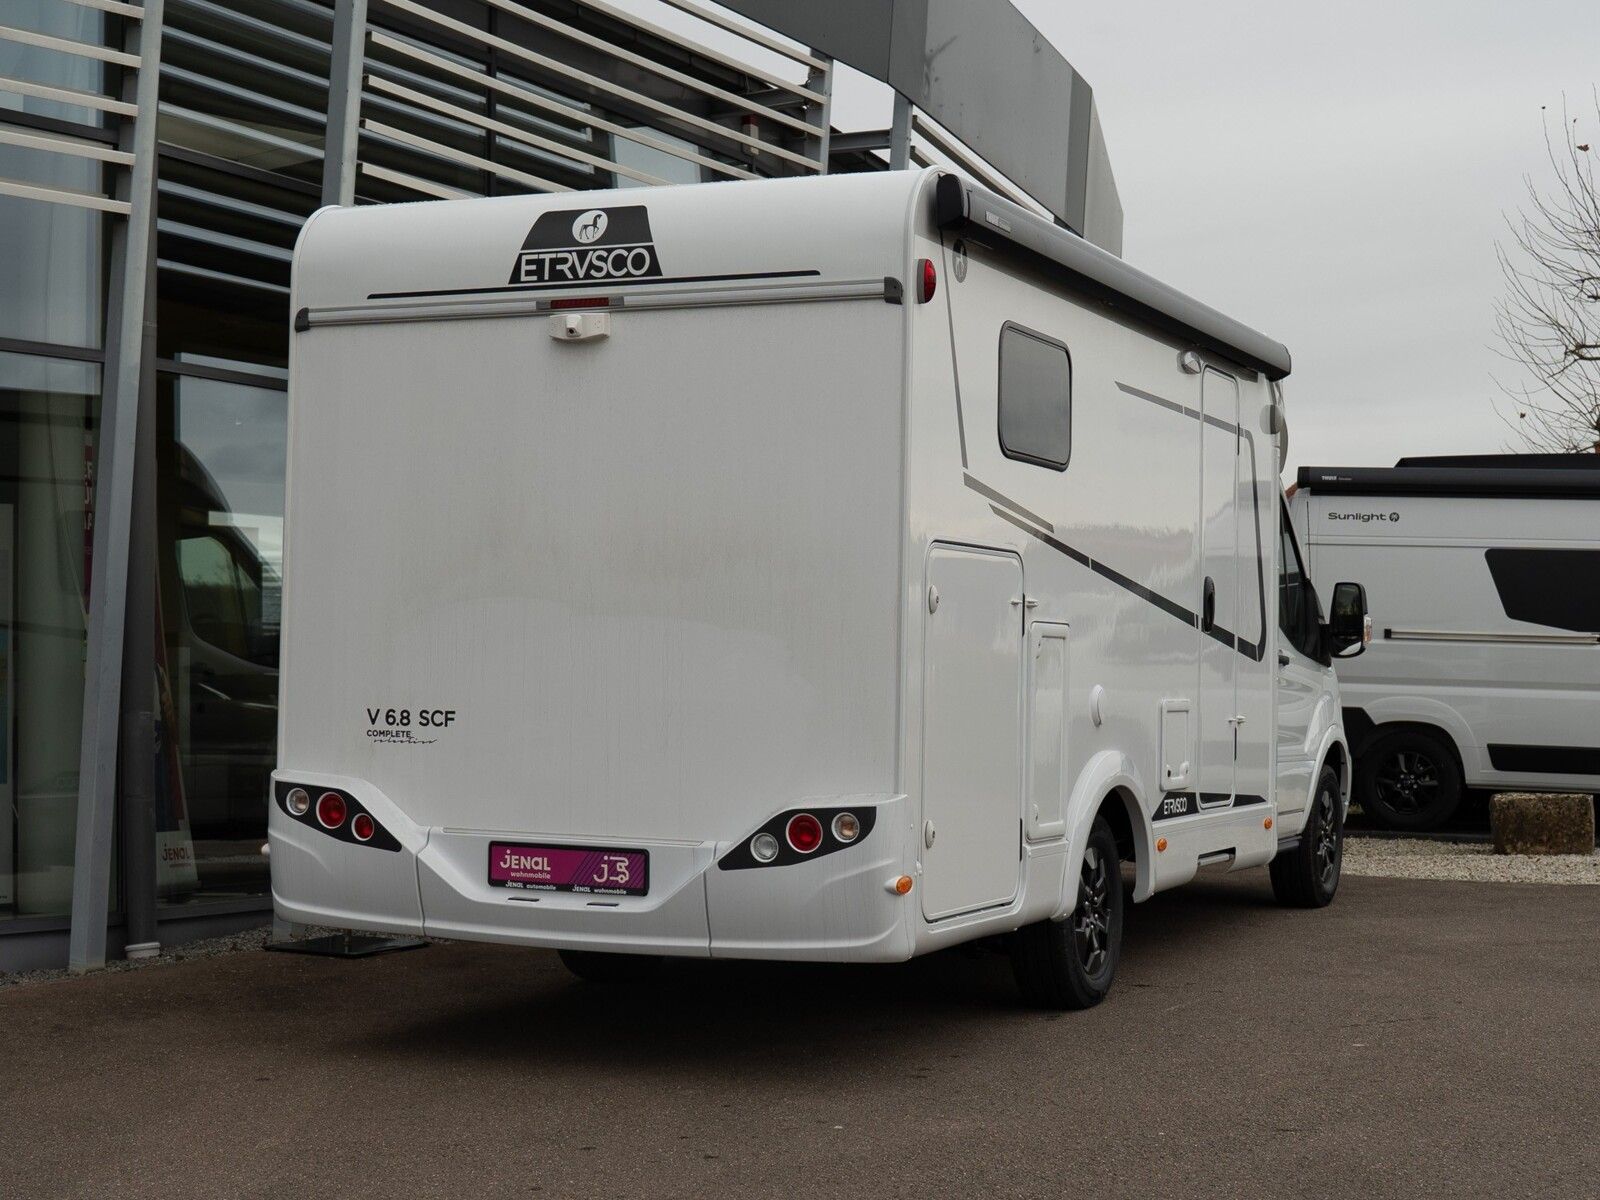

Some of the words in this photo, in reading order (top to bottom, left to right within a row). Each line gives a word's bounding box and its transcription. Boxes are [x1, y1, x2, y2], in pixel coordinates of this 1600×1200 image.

[1328, 512, 1387, 523] Sunlight
[367, 708, 380, 726] V
[385, 708, 411, 726] 6.8
[419, 709, 456, 727] SCF
[366, 729, 412, 738] COMPLETE
[510, 870, 551, 880] wohnmobile
[526, 883, 557, 891] automobile
[594, 888, 627, 896] wohnmobile
